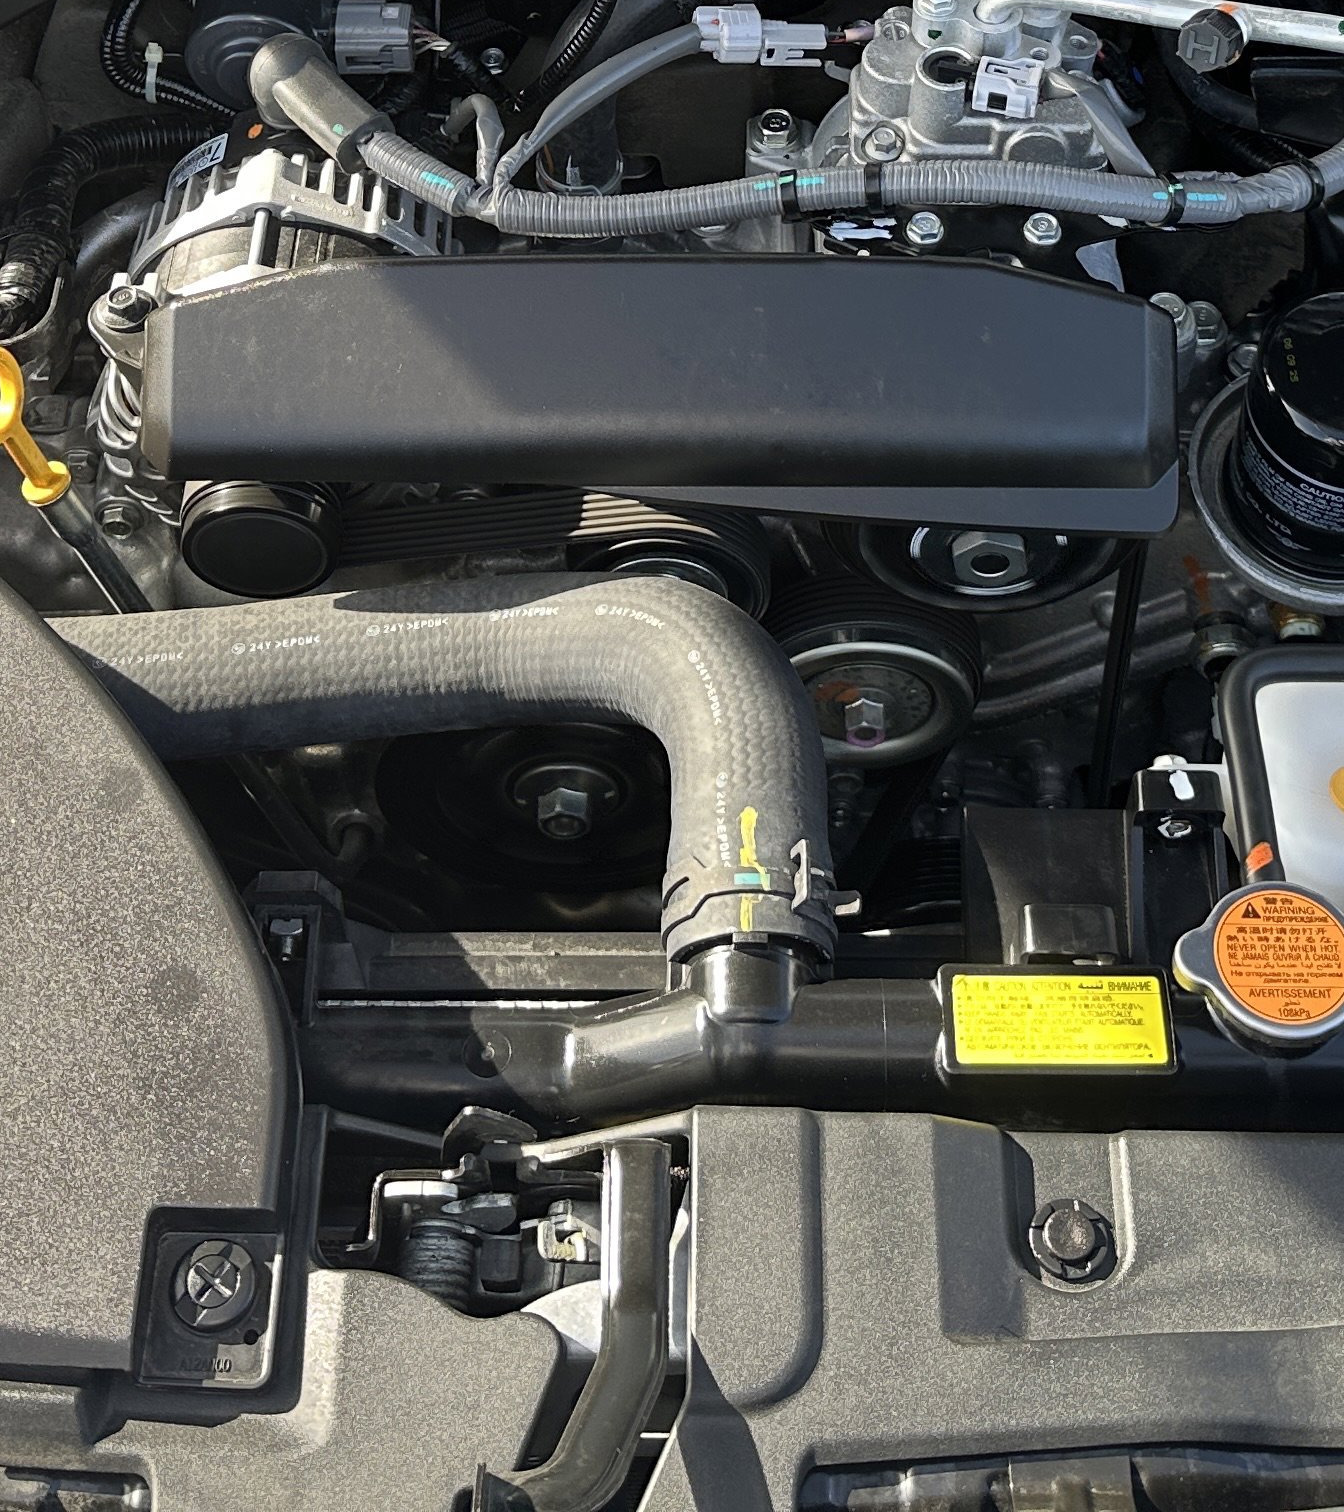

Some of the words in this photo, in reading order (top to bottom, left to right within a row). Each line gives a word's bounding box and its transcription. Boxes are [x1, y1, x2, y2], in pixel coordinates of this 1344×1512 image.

[1186, 29, 1220, 65] H
[1261, 906, 1315, 915] WARNING
[1227, 943, 1256, 952] NEVER
[1261, 944, 1285, 953] OPEN
[1289, 944, 1316, 953] WHEN
[1228, 952, 1237, 960] NE
[1241, 952, 1269, 961] JAMAIS
[1273, 953, 1302, 961] OUVRIR
[1249, 988, 1332, 998] AVERTISSEMENT
